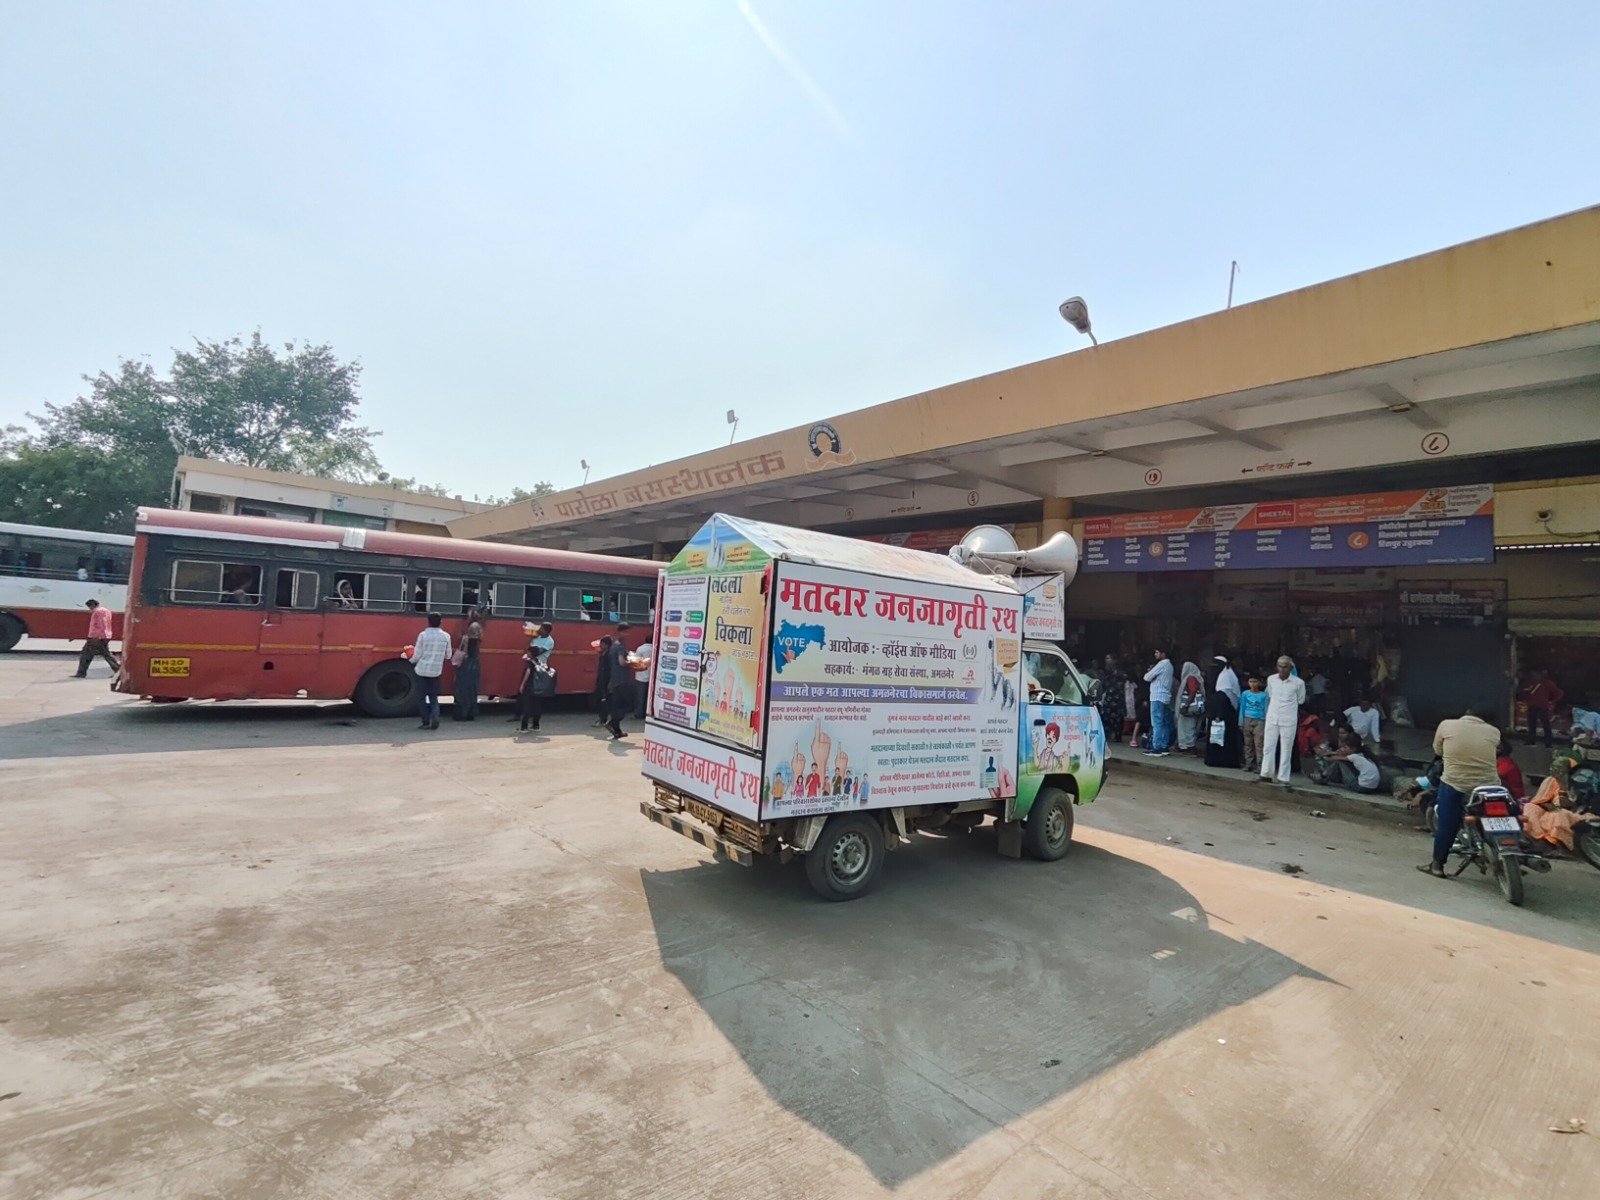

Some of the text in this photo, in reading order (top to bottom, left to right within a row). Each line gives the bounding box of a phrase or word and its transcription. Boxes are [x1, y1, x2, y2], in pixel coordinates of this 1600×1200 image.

[554, 450, 788, 517] पारोळा बसस्थानक
[780, 578, 1018, 638] मतदार जनजागृती रथ
[715, 616, 753, 645] विकला
[778, 637, 806, 648] VOTE
[828, 637, 870, 655] आयोजक
[881, 640, 907, 660] व्हॉईस
[909, 642, 928, 659] ऑफ
[929, 643, 957, 661] मीडिया
[783, 684, 809, 697] आपले
[811, 686, 825, 698] एक
[826, 687, 839, 697] मत
[643, 738, 760, 805] मतदार जनजागृती रथ
